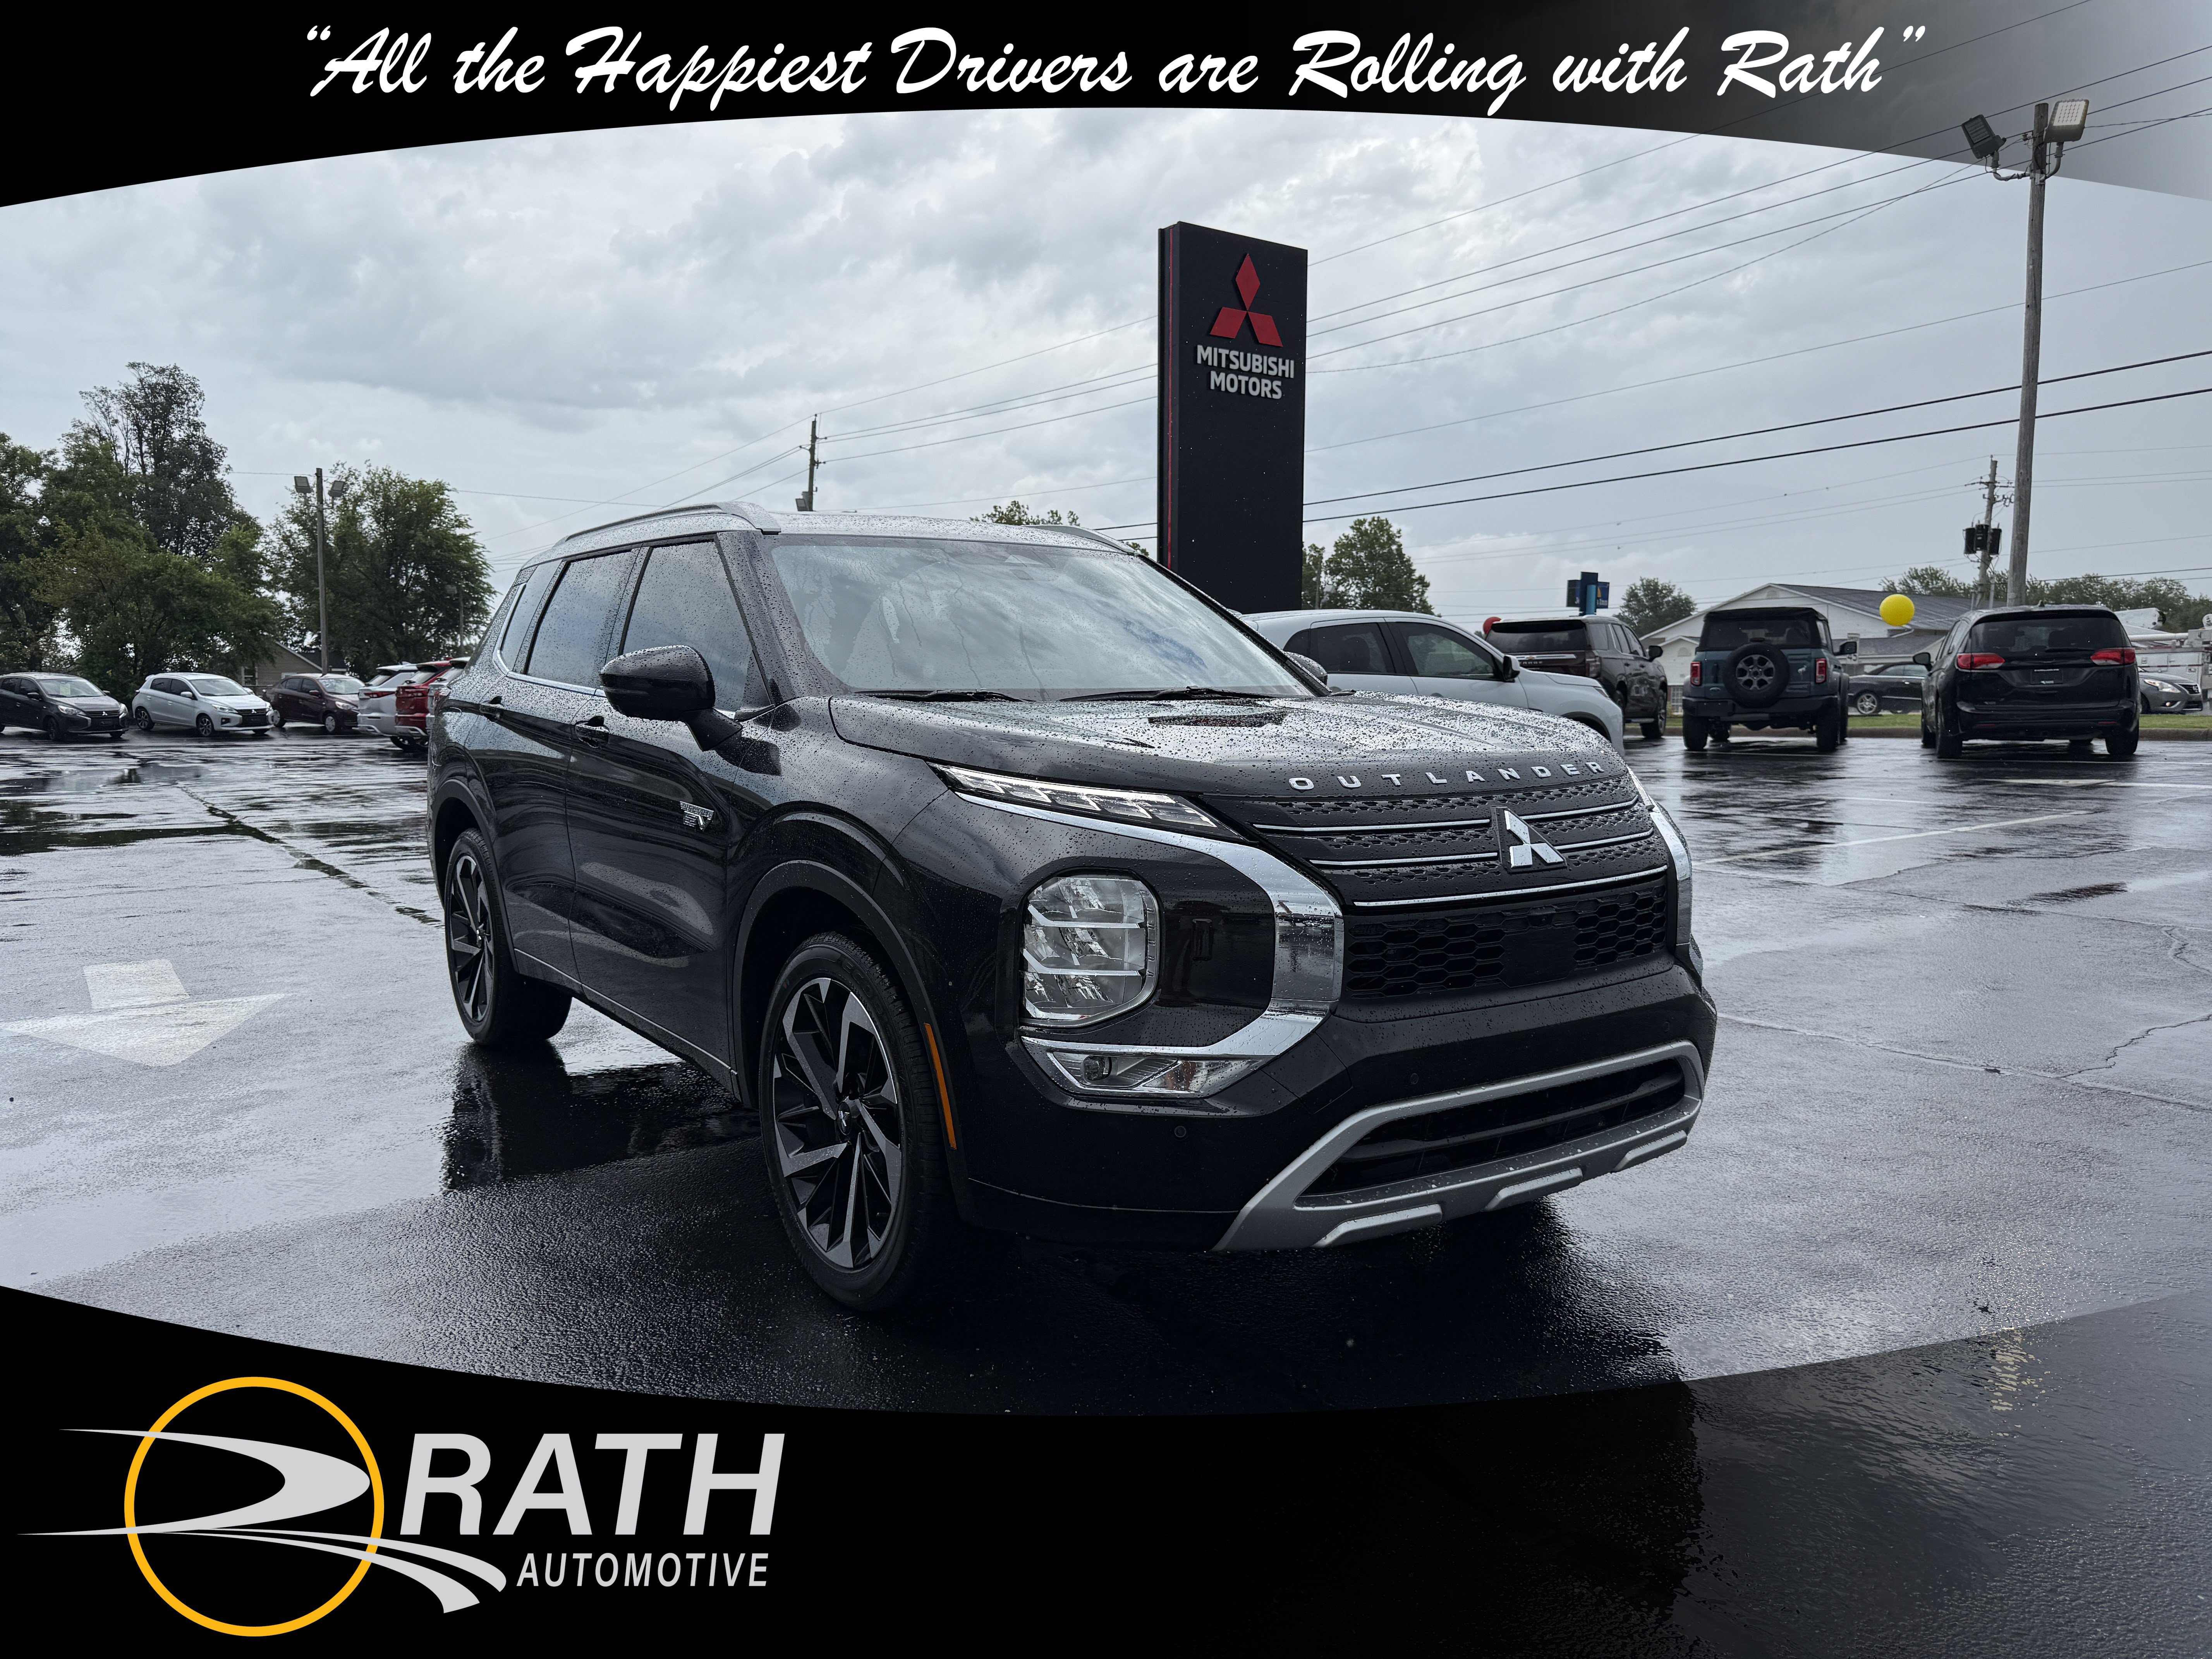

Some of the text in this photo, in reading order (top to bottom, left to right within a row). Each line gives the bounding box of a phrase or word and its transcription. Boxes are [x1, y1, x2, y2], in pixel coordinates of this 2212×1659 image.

[1197, 345, 1295, 378] MITSUBISHI
[1210, 371, 1282, 400] MOTORS
[1289, 761, 1605, 790] OUTLANDER
